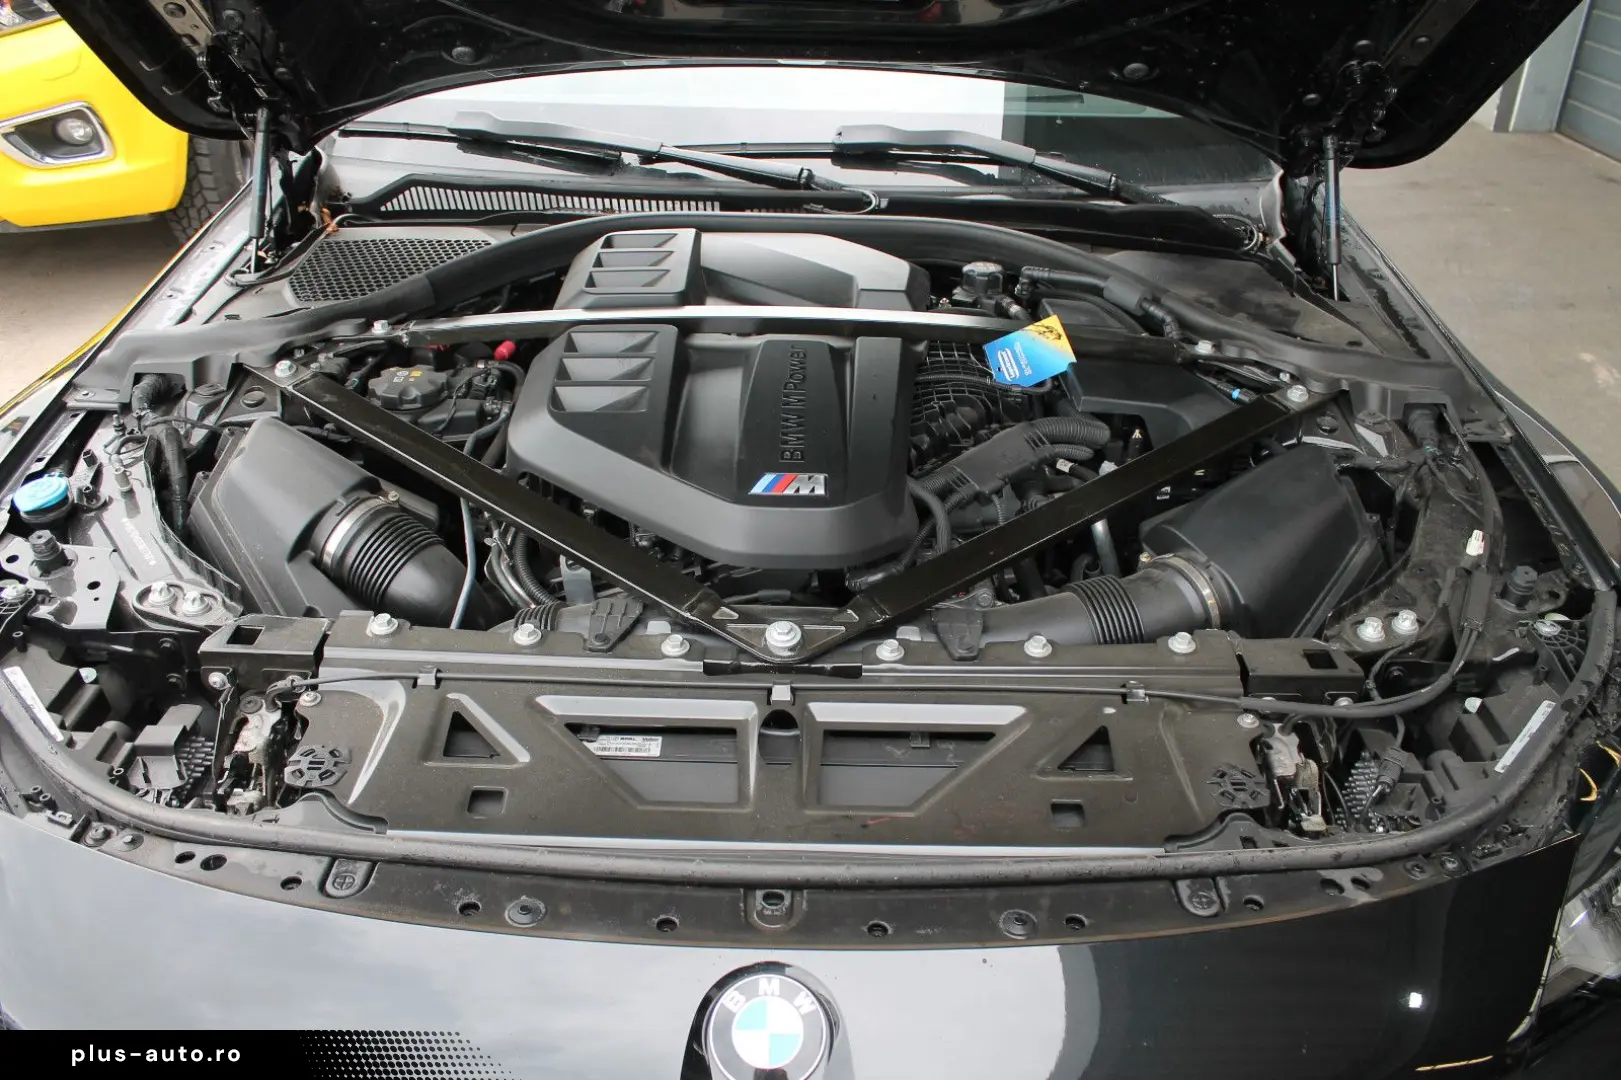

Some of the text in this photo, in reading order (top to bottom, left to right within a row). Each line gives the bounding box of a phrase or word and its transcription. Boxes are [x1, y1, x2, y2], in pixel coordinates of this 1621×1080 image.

[779, 413, 805, 463] BMW
[782, 473, 828, 496] M
[722, 978, 817, 1015] BMW
